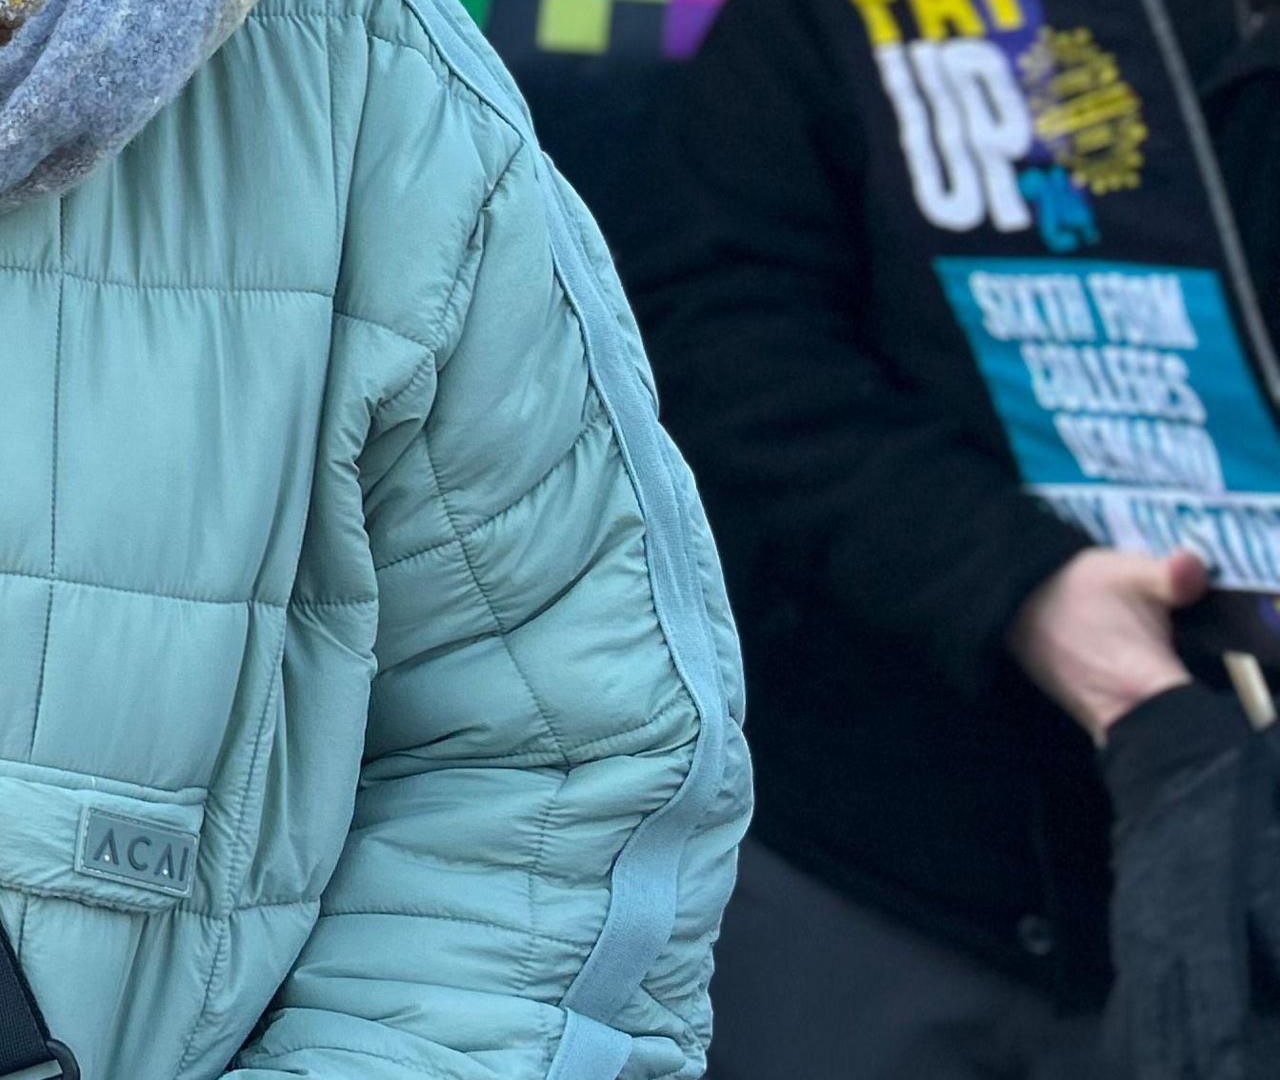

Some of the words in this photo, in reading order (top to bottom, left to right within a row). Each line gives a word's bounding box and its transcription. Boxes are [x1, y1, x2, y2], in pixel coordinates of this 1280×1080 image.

[874, 36, 1033, 233] UP
[968, 270, 1096, 343] SIXTH
[1087, 270, 1199, 351] FORM
[1020, 342, 1208, 425] COLLEGES
[1053, 413, 1227, 493] DEMAND
[93, 828, 189, 882] ACAI
